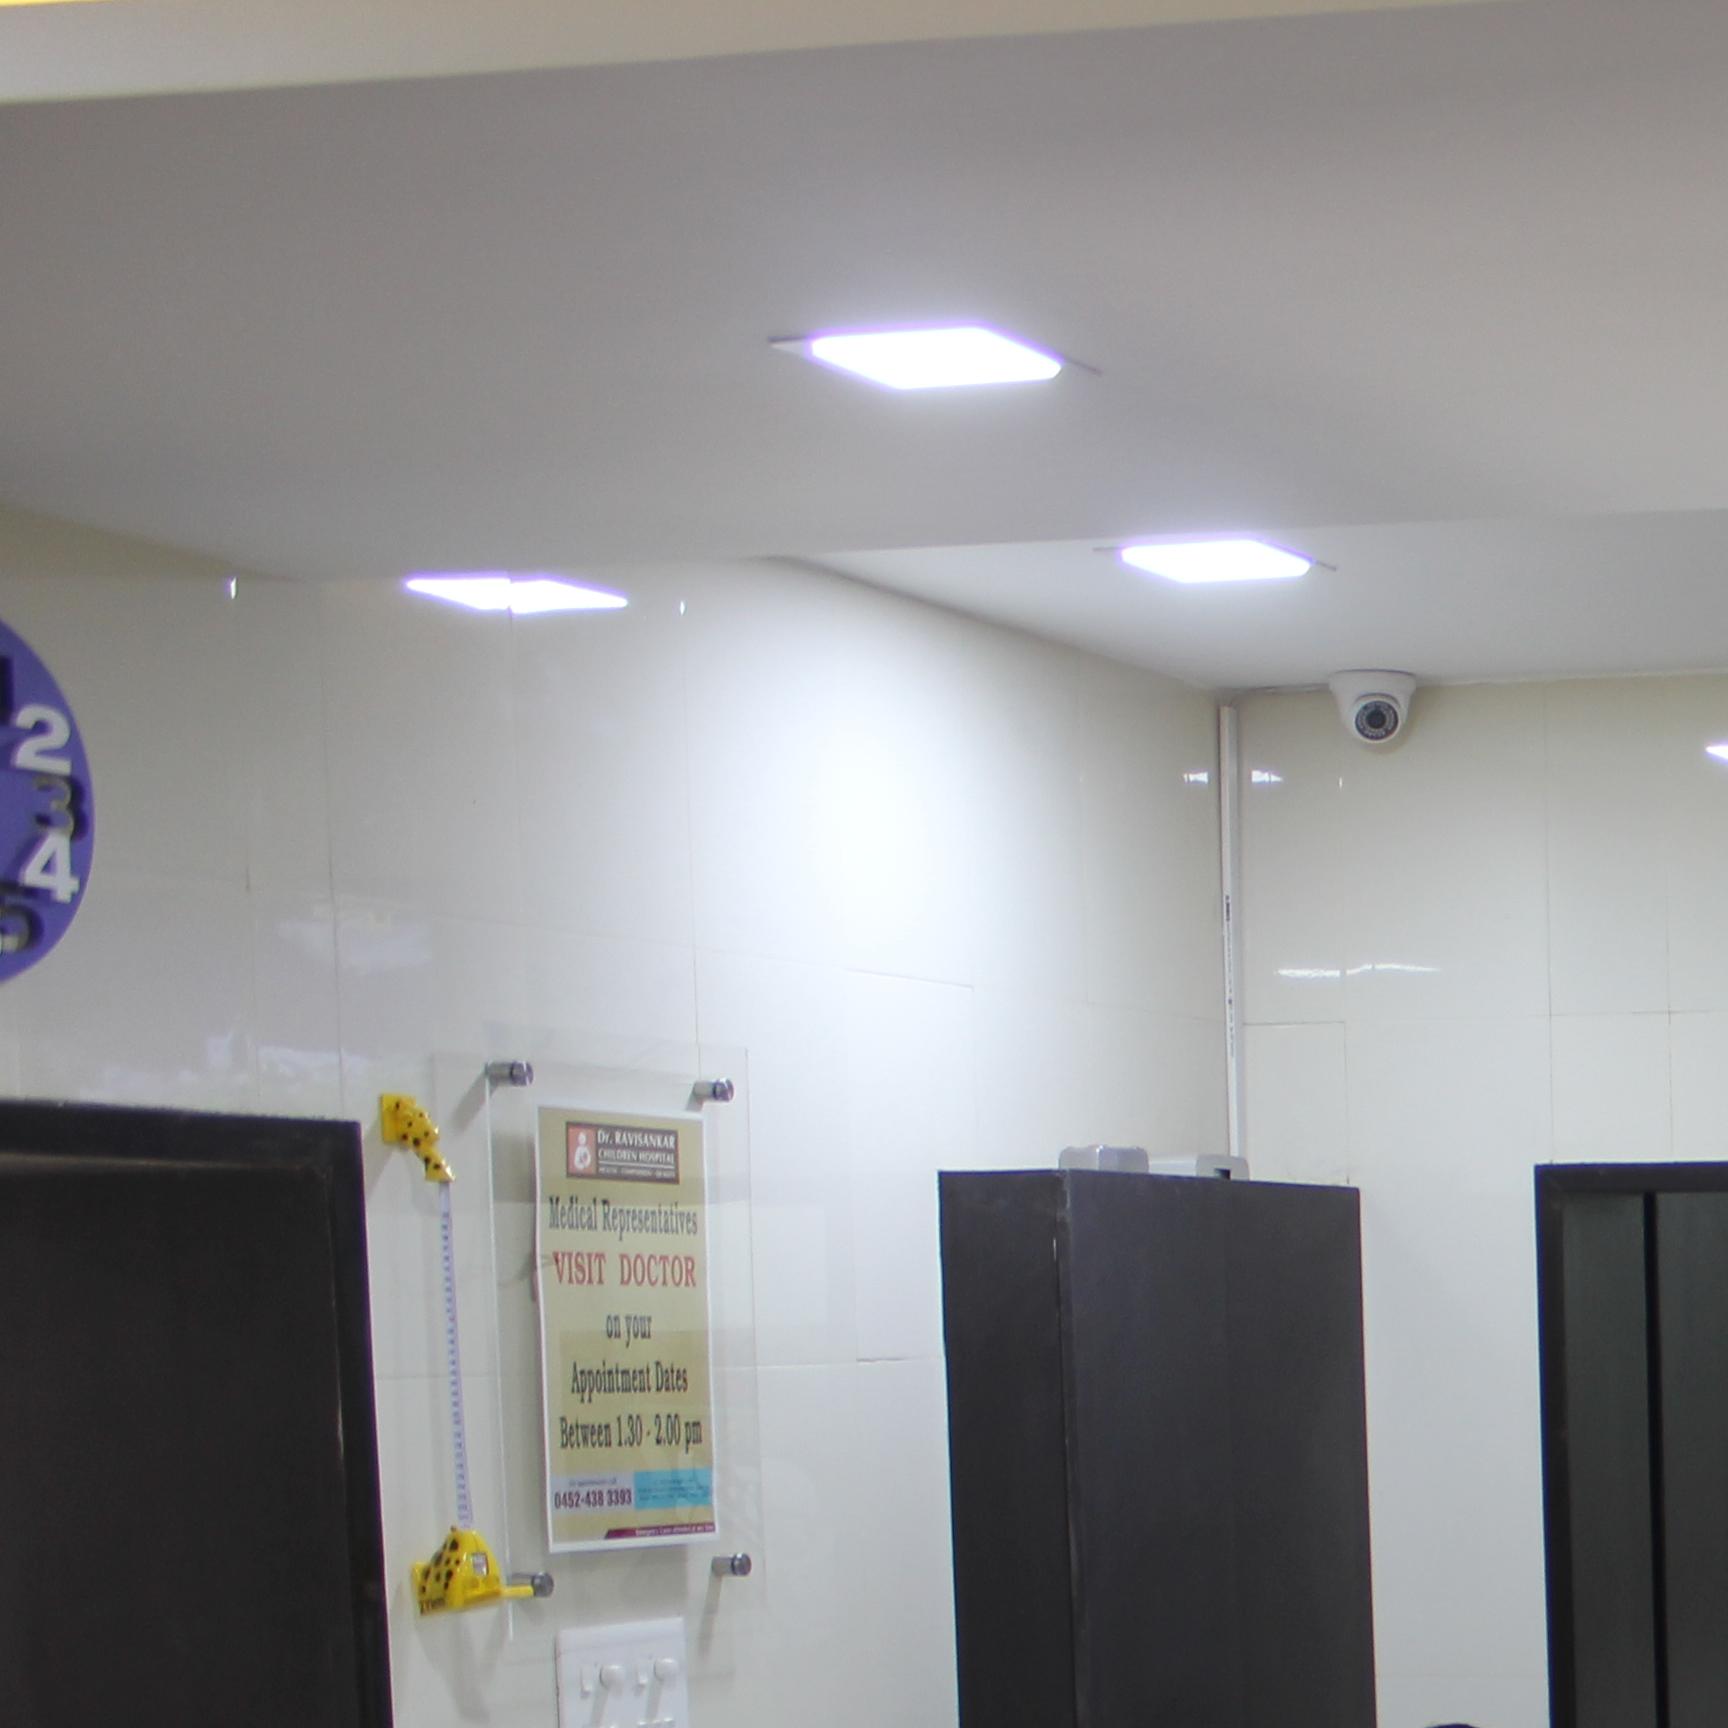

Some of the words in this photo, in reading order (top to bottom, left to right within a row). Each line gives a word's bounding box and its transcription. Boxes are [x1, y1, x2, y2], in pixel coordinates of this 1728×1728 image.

[15, 705, 72, 775] 2
[24, 830, 80, 903] 4
[597, 1130, 613, 1145] Dr.
[614, 1131, 676, 1149] RAVISANKAR
[549, 1195, 597, 1231] Medical
[602, 1199, 698, 1241] Representatives
[552, 1251, 607, 1285] VISIT
[619, 1253, 697, 1288] DOCTOR
[606, 1314, 621, 1339] on
[625, 1315, 653, 1348] your
[571, 1360, 651, 1403] Appointment
[655, 1360, 688, 1393] Dates
[560, 1415, 612, 1449] Between
[617, 1413, 643, 1447] 1.30
[654, 1412, 681, 1446] 2.00
[685, 1420, 703, 1455] pm
[554, 1489, 604, 1510] 0452-438
[607, 1487, 632, 1508] 3393
